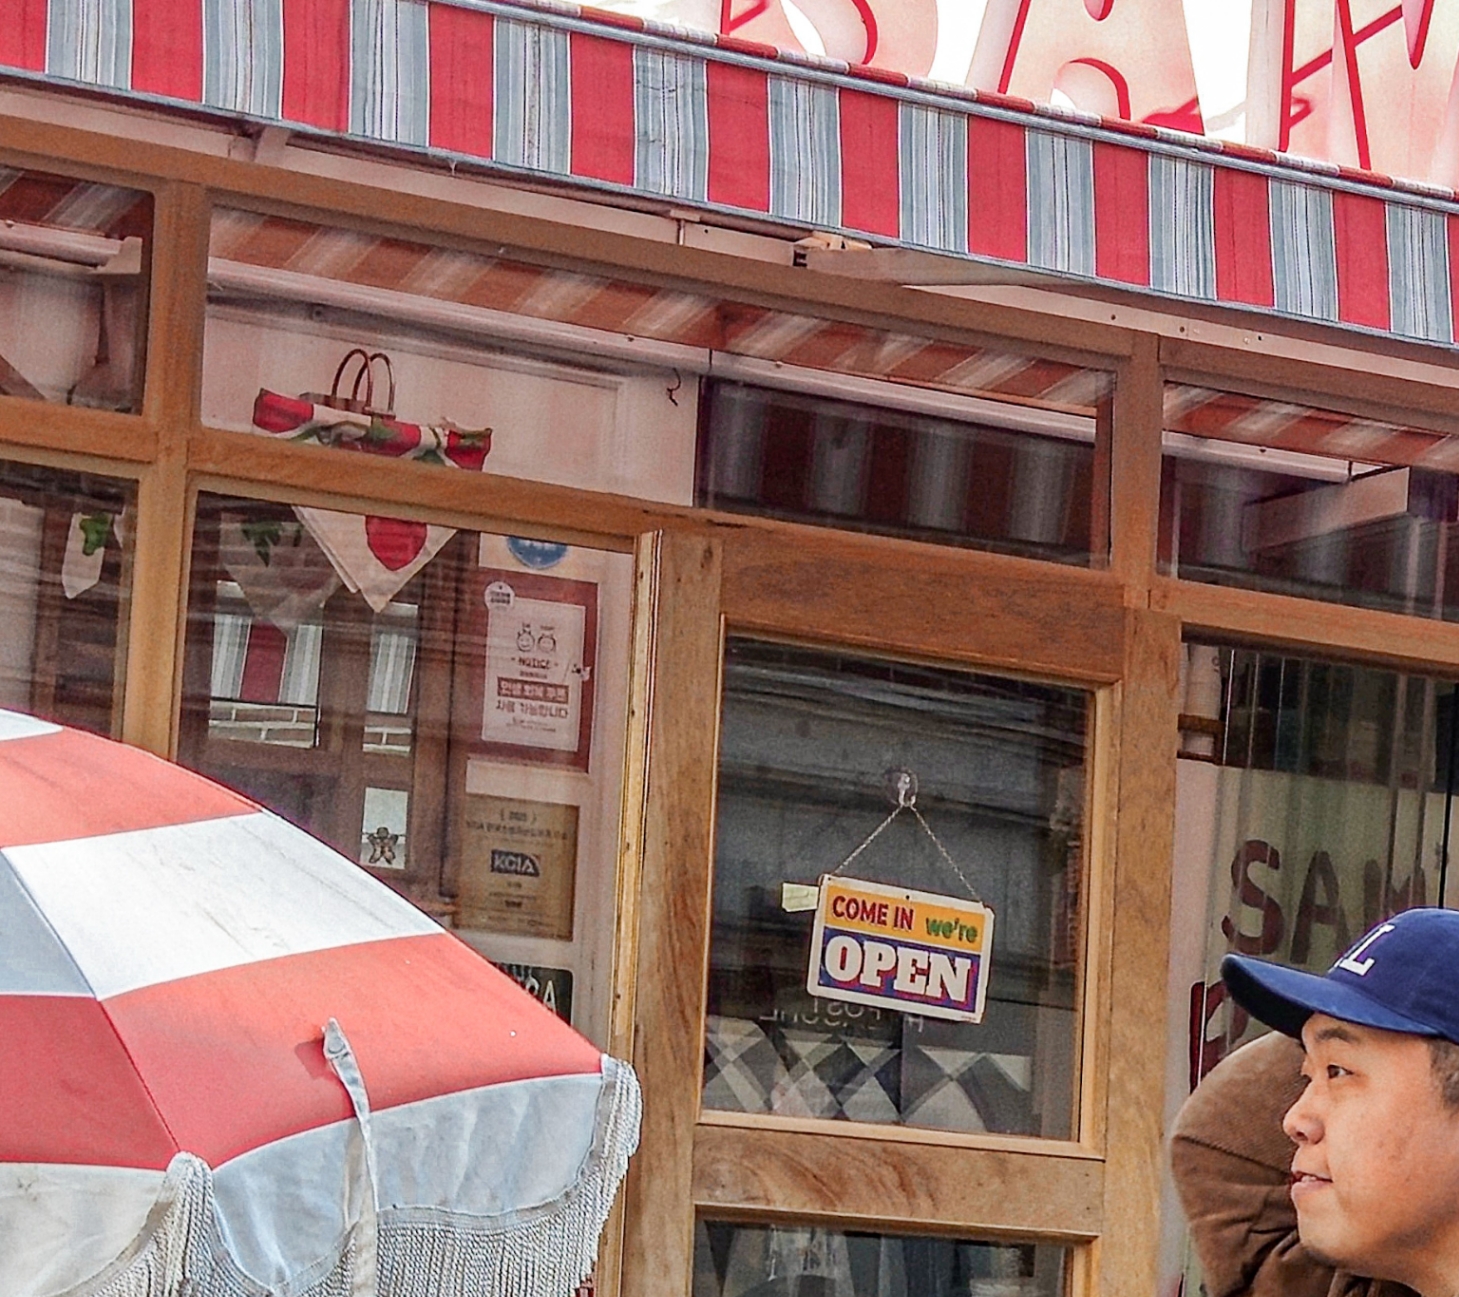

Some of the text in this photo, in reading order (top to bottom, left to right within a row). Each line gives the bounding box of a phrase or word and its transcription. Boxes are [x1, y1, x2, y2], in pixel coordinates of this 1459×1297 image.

[833, 896, 978, 943] COME IN we're
[824, 936, 971, 1002] OPEN
